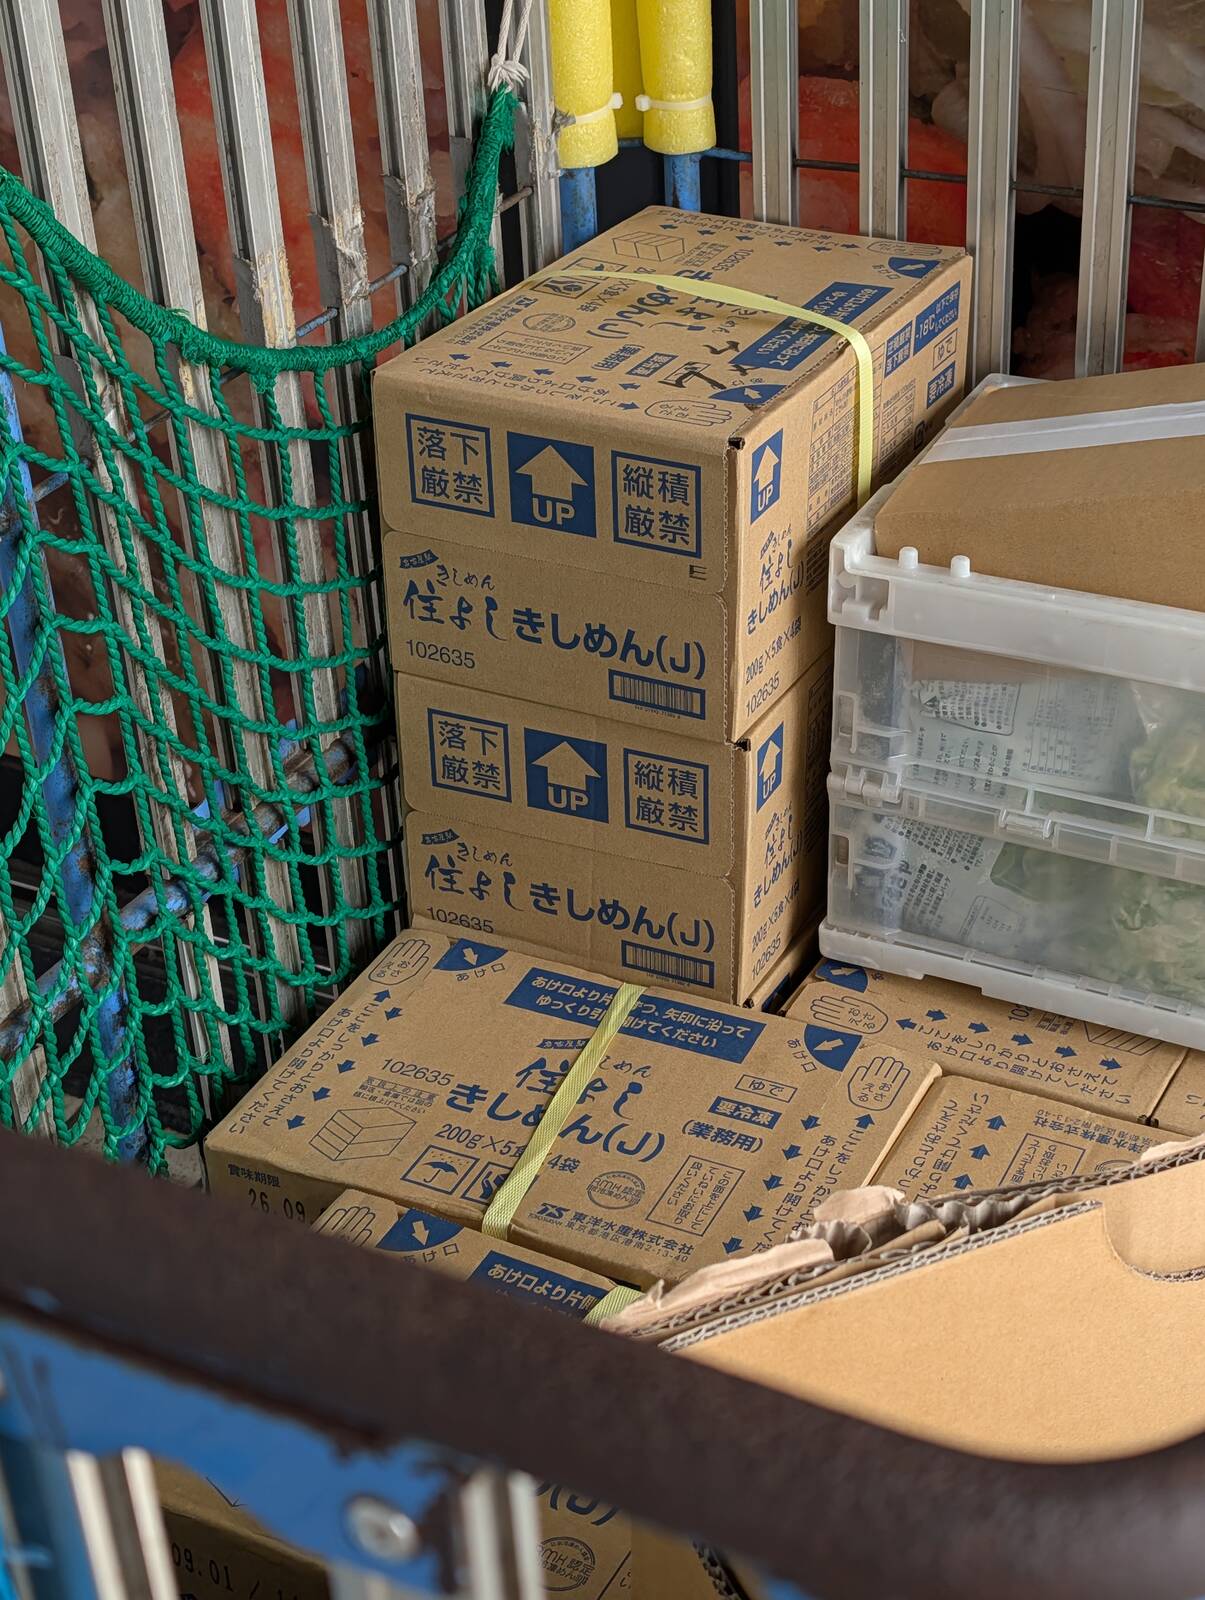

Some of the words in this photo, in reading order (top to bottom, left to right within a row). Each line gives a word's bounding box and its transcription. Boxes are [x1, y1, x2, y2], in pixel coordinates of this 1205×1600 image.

[418, 426, 480, 465] 落下
[421, 465, 483, 504] 厳禁
[623, 464, 690, 507] 縦積
[757, 484, 774, 512] UP
[532, 496, 576, 525] UP
[625, 504, 690, 546] 厳禁
[436, 564, 495, 591] きしめん
[747, 560, 804, 635] きしめん(J)
[403, 578, 507, 642] 住よし
[406, 640, 476, 670] 102635
[512, 608, 706, 680] きしめん(J)
[746, 671, 779, 718] 102635
[438, 720, 498, 756] 落下
[441, 755, 500, 791] 厳禁
[634, 760, 698, 800] 縦積
[763, 772, 777, 799] UP
[547, 783, 589, 811] UP
[636, 796, 698, 834] 厳禁
[457, 842, 513, 867] きしめん
[425, 854, 526, 911] 住よし
[427, 906, 495, 934] 102635
[530, 882, 715, 953] きしめん(J)
[455, 961, 505, 982] あけ口
[752, 932, 781, 982] 102635
[532, 974, 750, 1040] あけ口より片つ、矢印に沿って
[536, 994, 719, 1049] ゆっくり引開けてください
[229, 1007, 353, 1134] あけ口より開けてください
[262, 1003, 381, 1127] ここをしっかりとおさえて
[383, 1058, 455, 1086] 102635
[785, 1038, 817, 1074] あけ口
[918, 1023, 1118, 1085] ここをしっかりとおさえて
[926, 1041, 1132, 1105] あけ口より開けてください
[748, 1079, 784, 1097] ゆで
[715, 1101, 775, 1125] 要冷凍
[681, 1119, 764, 1153] (業務用)
[898, 1099, 958, 1194] っかりとおさえて
[674, 1166, 719, 1225] ていねいにお取り
[691, 1170, 734, 1230] この面を上にして
[570, 1211, 695, 1256] 東洋水産株式会社
